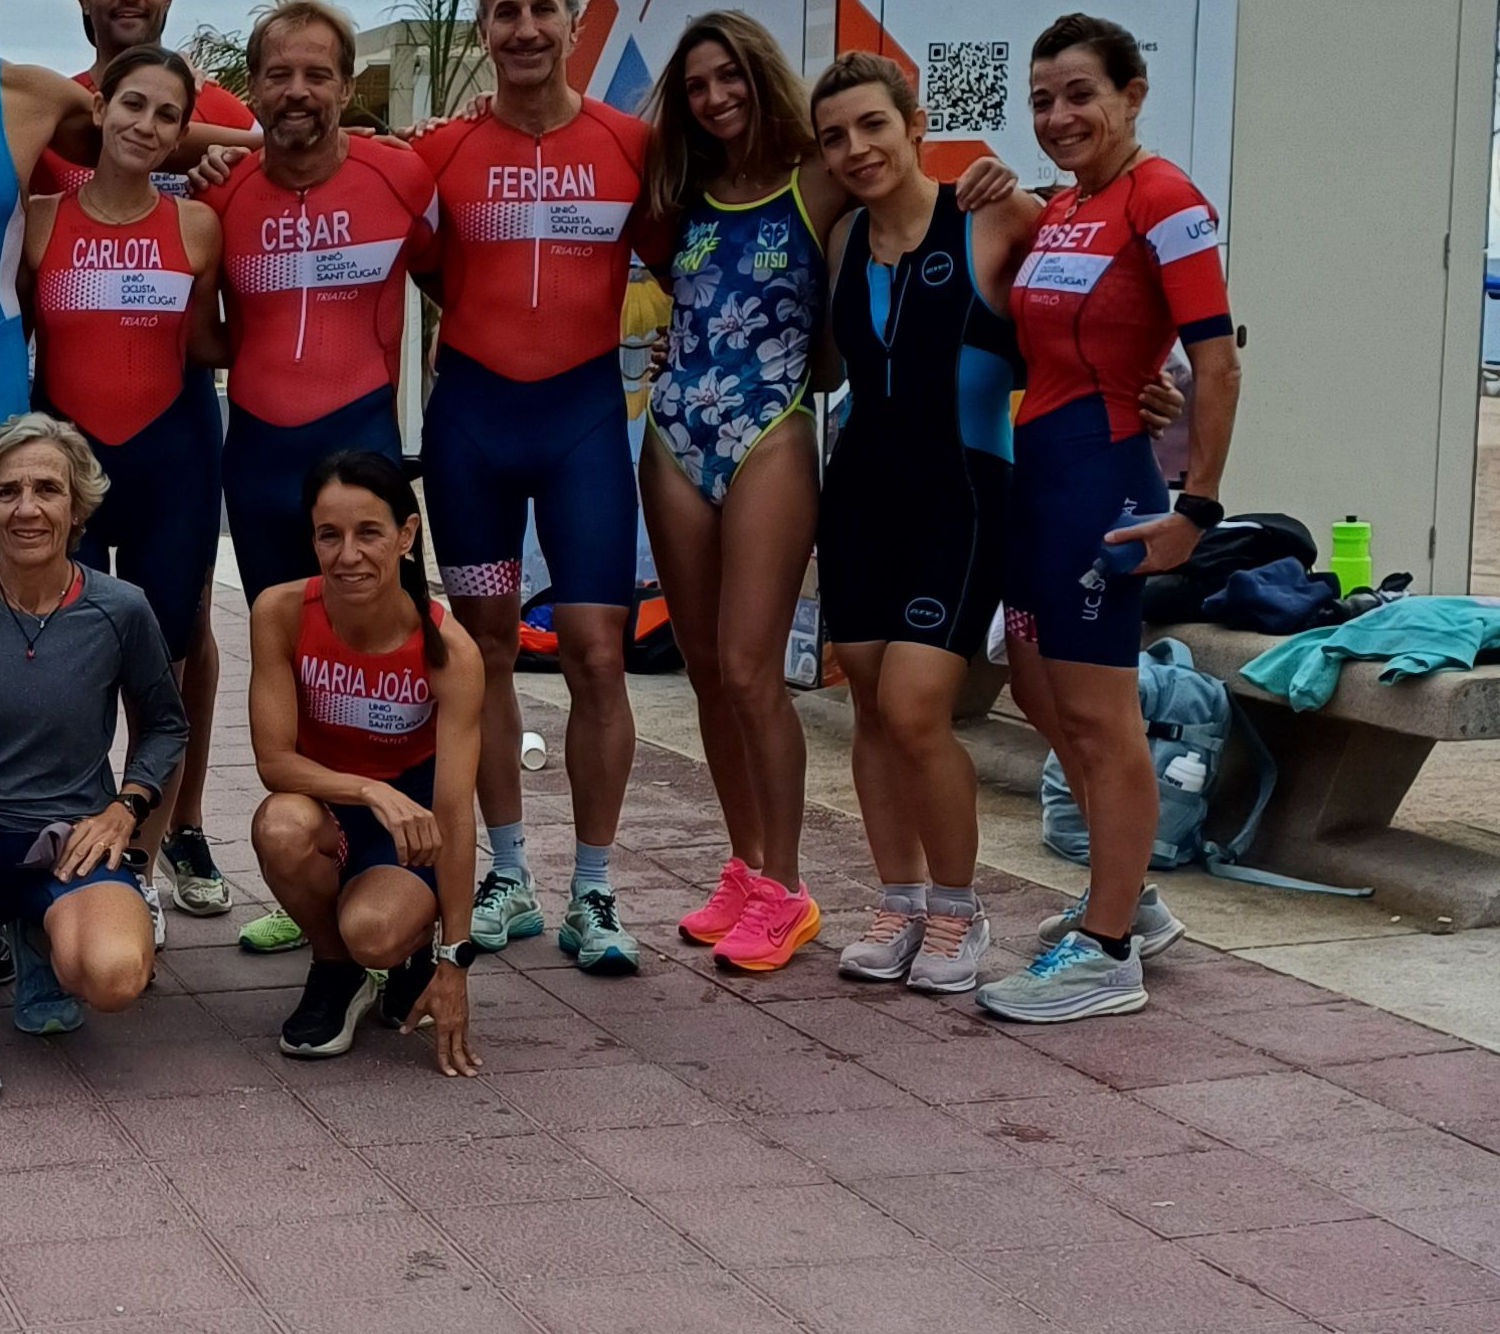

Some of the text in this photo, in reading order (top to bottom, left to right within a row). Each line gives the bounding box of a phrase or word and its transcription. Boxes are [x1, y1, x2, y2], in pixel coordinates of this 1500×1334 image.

[487, 163, 596, 199] FERRAN
[550, 204, 577, 214] UNIÓ
[261, 209, 352, 251] CÉSAR
[551, 225, 579, 234] SANT
[72, 237, 162, 269] CARLOTA
[316, 252, 343, 263] UNIÓ
[754, 251, 788, 269] OTSO
[121, 273, 144, 283] UNIÓ
[316, 271, 345, 282] SANT
[121, 295, 145, 304] SANT
[300, 655, 430, 704] MARIA JOÃO
